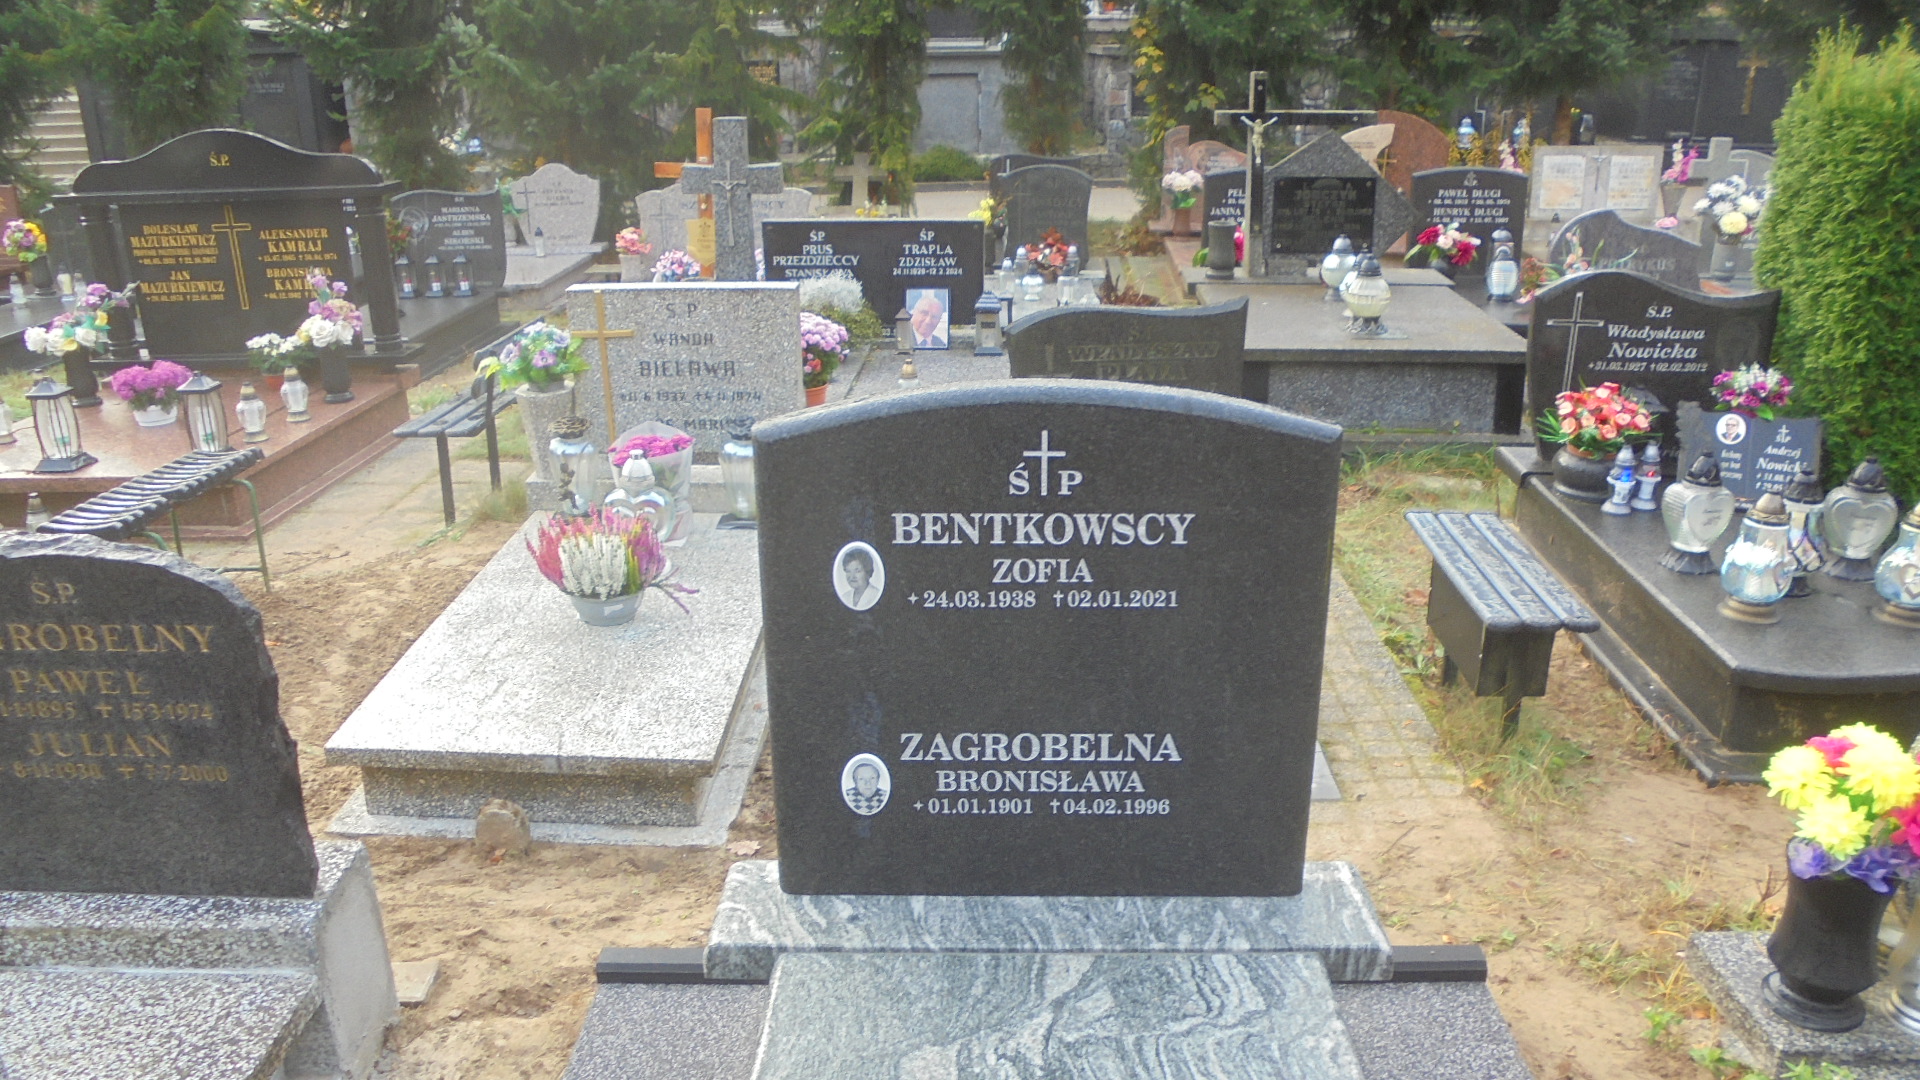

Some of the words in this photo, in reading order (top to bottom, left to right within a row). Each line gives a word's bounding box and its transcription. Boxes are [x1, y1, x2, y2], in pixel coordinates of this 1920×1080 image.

[1210, 207, 1241, 216] JANINA
[142, 223, 198, 235] BOLESŁAW
[259, 228, 328, 240] ALEKSANDER
[130, 234, 217, 248] MAZURKIEWICZ
[267, 240, 322, 253] KAMRAJ
[802, 244, 833, 255] PRUS
[903, 244, 953, 255] TRAPLA
[899, 257, 957, 267] ZDZISŁAW
[169, 270, 191, 281] JAN
[139, 280, 226, 293] MAZURKIEWICZ
[653, 332, 714, 346] WANDA
[1607, 324, 1706, 341] Władysława
[1607, 342, 1698, 359] Nowicka
[1008, 462, 1030, 495] Ś
[1057, 470, 1083, 495] P
[891, 512, 1196, 545] BENTKOWSCY
[992, 558, 1094, 583] ZOFIA
[923, 589, 1036, 608] 24.03.1938
[1066, 589, 1178, 608] 02.01.2021
[0, 623, 214, 653] ROBELNY
[9, 669, 151, 695] PAWEŁ
[29, 733, 172, 757] JULIAN
[900, 732, 1182, 762] ZAGROBELNA
[936, 770, 1146, 793] BRONISŁAWA
[927, 797, 1033, 815] 01.01.1901
[1062, 797, 1171, 816] 04.02.1996
